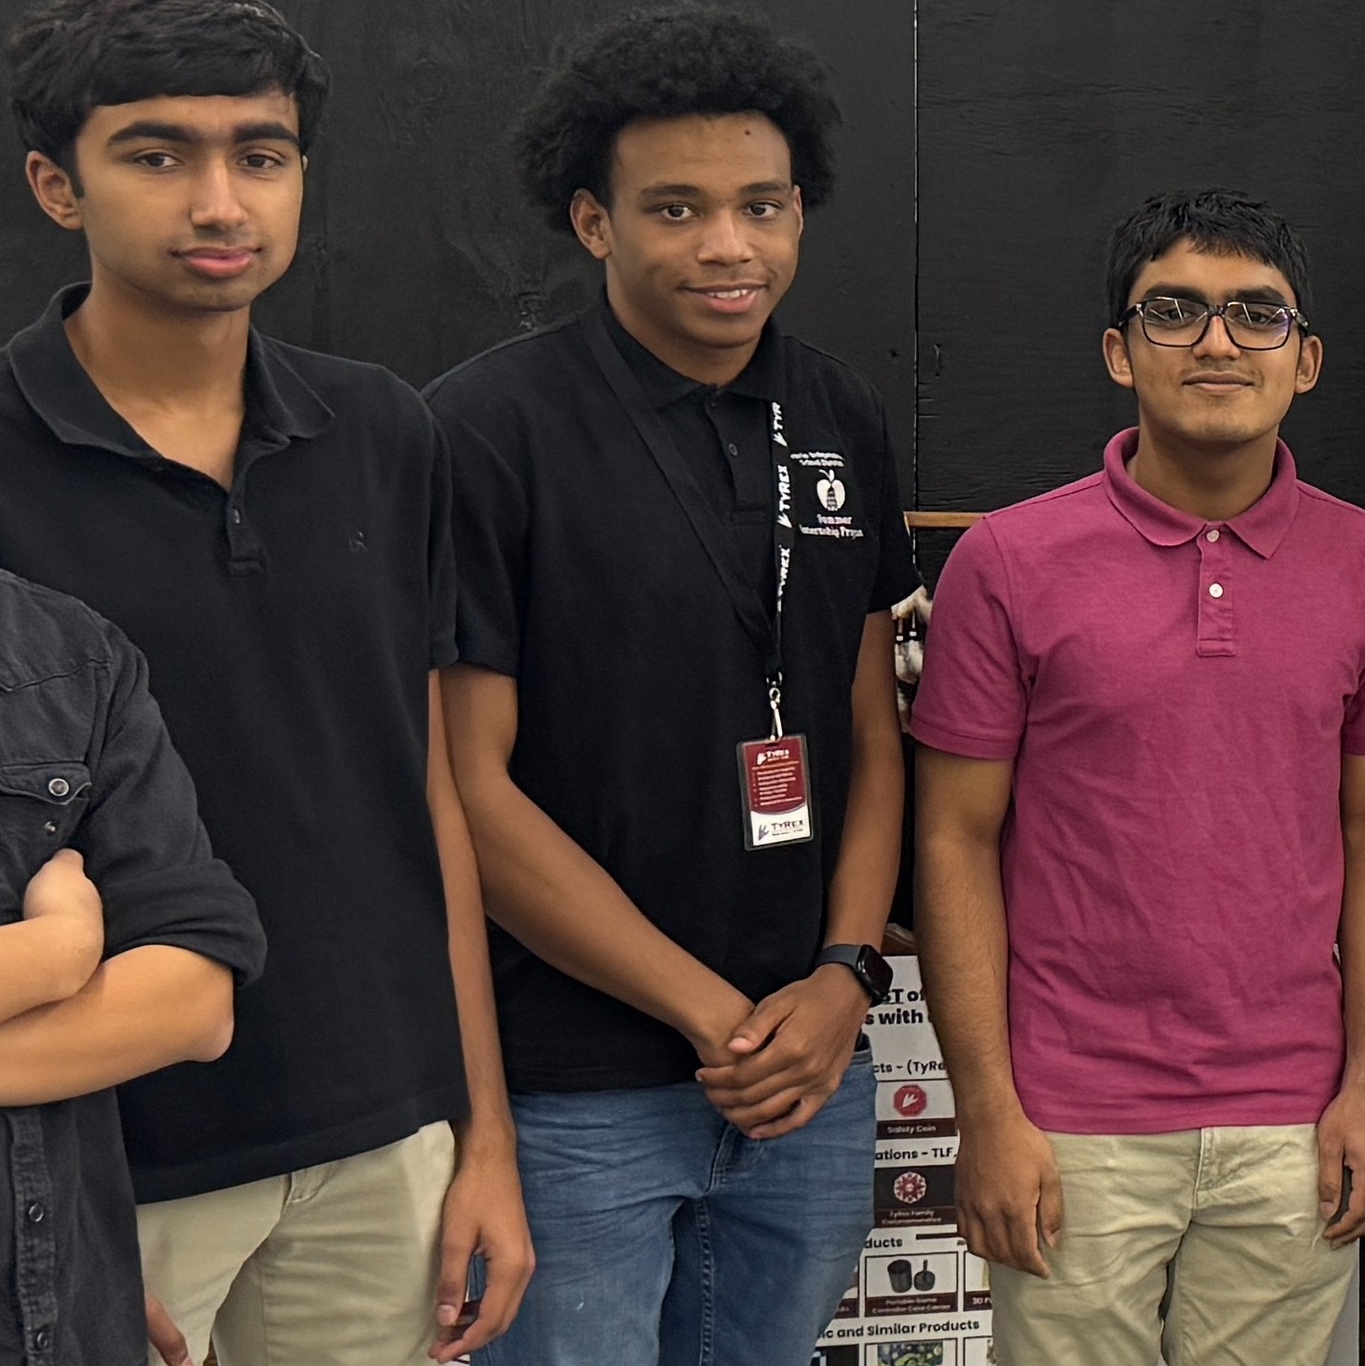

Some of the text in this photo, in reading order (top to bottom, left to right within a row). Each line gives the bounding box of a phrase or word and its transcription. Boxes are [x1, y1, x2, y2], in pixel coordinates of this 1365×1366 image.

[777, 464, 788, 518] TYREX
[879, 1008, 923, 1024] with
[865, 1237, 903, 1249] ducts
[837, 1326, 864, 1338] and
[867, 1323, 916, 1336] Similar
[919, 1320, 980, 1333] Products
